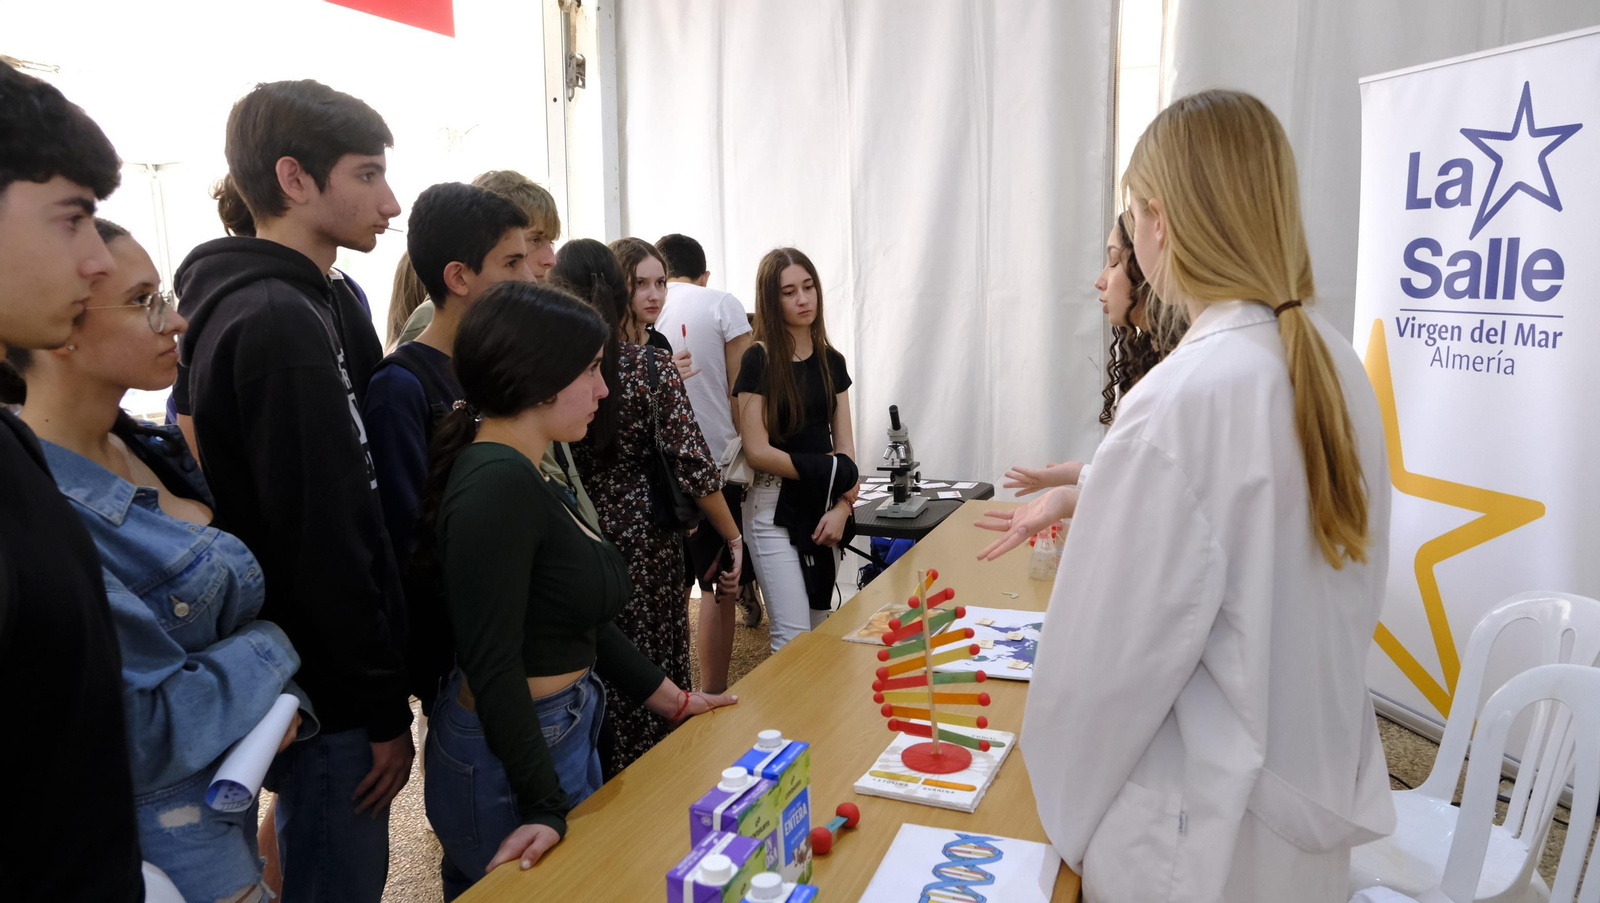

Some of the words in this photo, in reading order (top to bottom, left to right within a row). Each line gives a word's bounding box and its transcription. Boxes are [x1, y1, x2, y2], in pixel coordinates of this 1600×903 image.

[1405, 151, 1474, 210] La
[1399, 237, 1565, 302] Salle
[1395, 316, 1463, 347] Virgen
[1470, 319, 1507, 345] del
[1514, 322, 1563, 349] Mar
[1430, 346, 1516, 376] Almería
[784, 802, 808, 837] ENTERA
